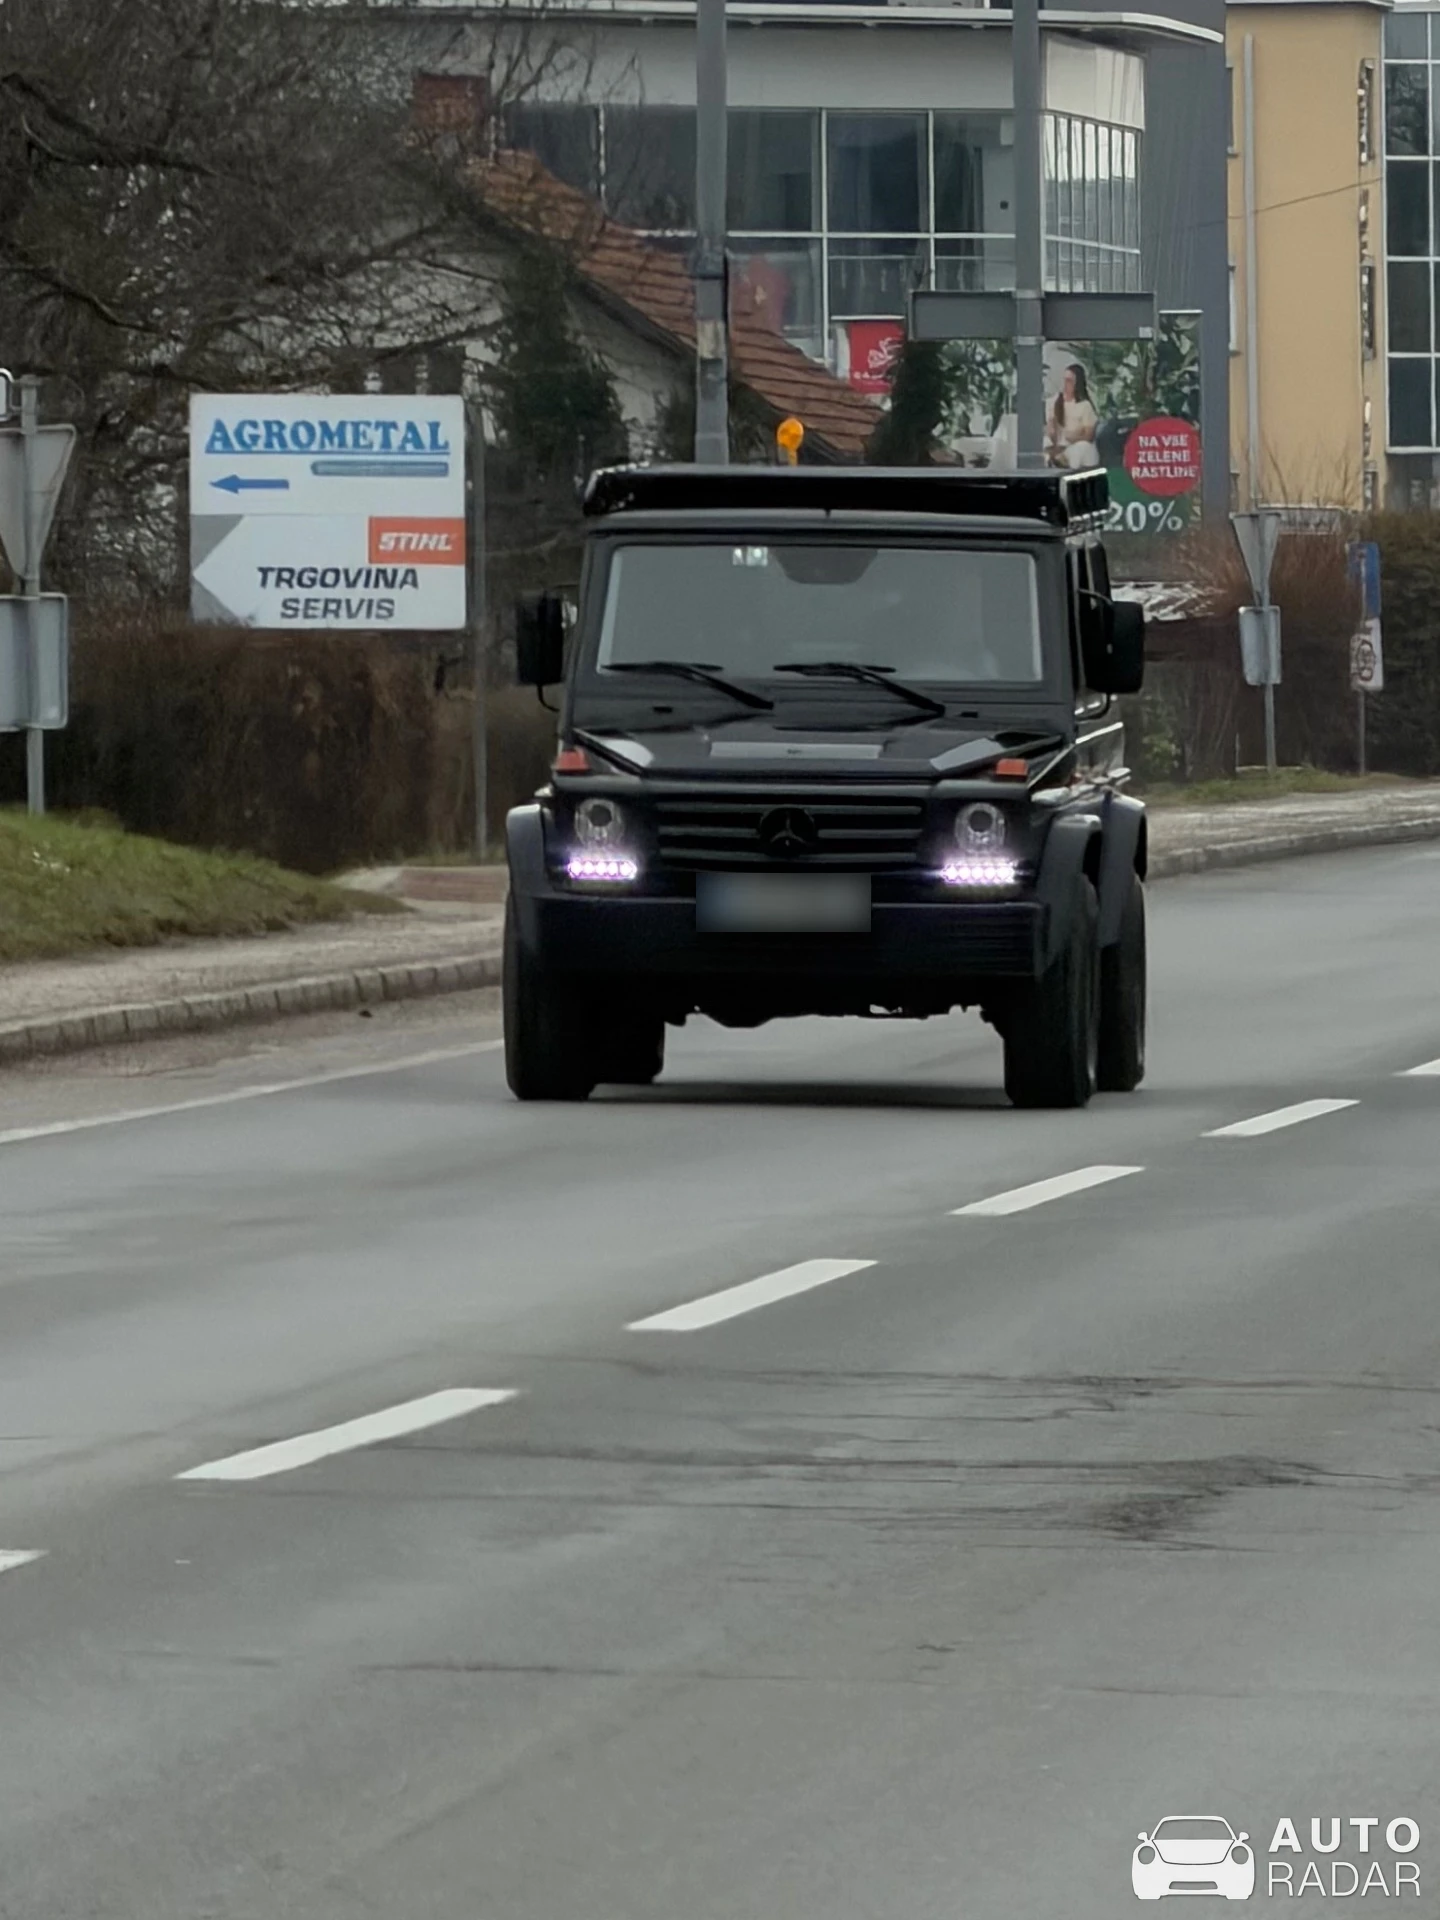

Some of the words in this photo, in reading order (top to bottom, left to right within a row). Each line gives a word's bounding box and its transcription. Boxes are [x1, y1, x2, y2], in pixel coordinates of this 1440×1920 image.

[205, 418, 450, 450] AGROMETAL
[1138, 436, 1159, 447] NA
[1161, 434, 1189, 446] VSE
[1138, 450, 1191, 463] ZELENE
[378, 531, 453, 551] STIHL
[257, 566, 419, 589] TRGOVINA
[280, 597, 395, 619] SERVIS
